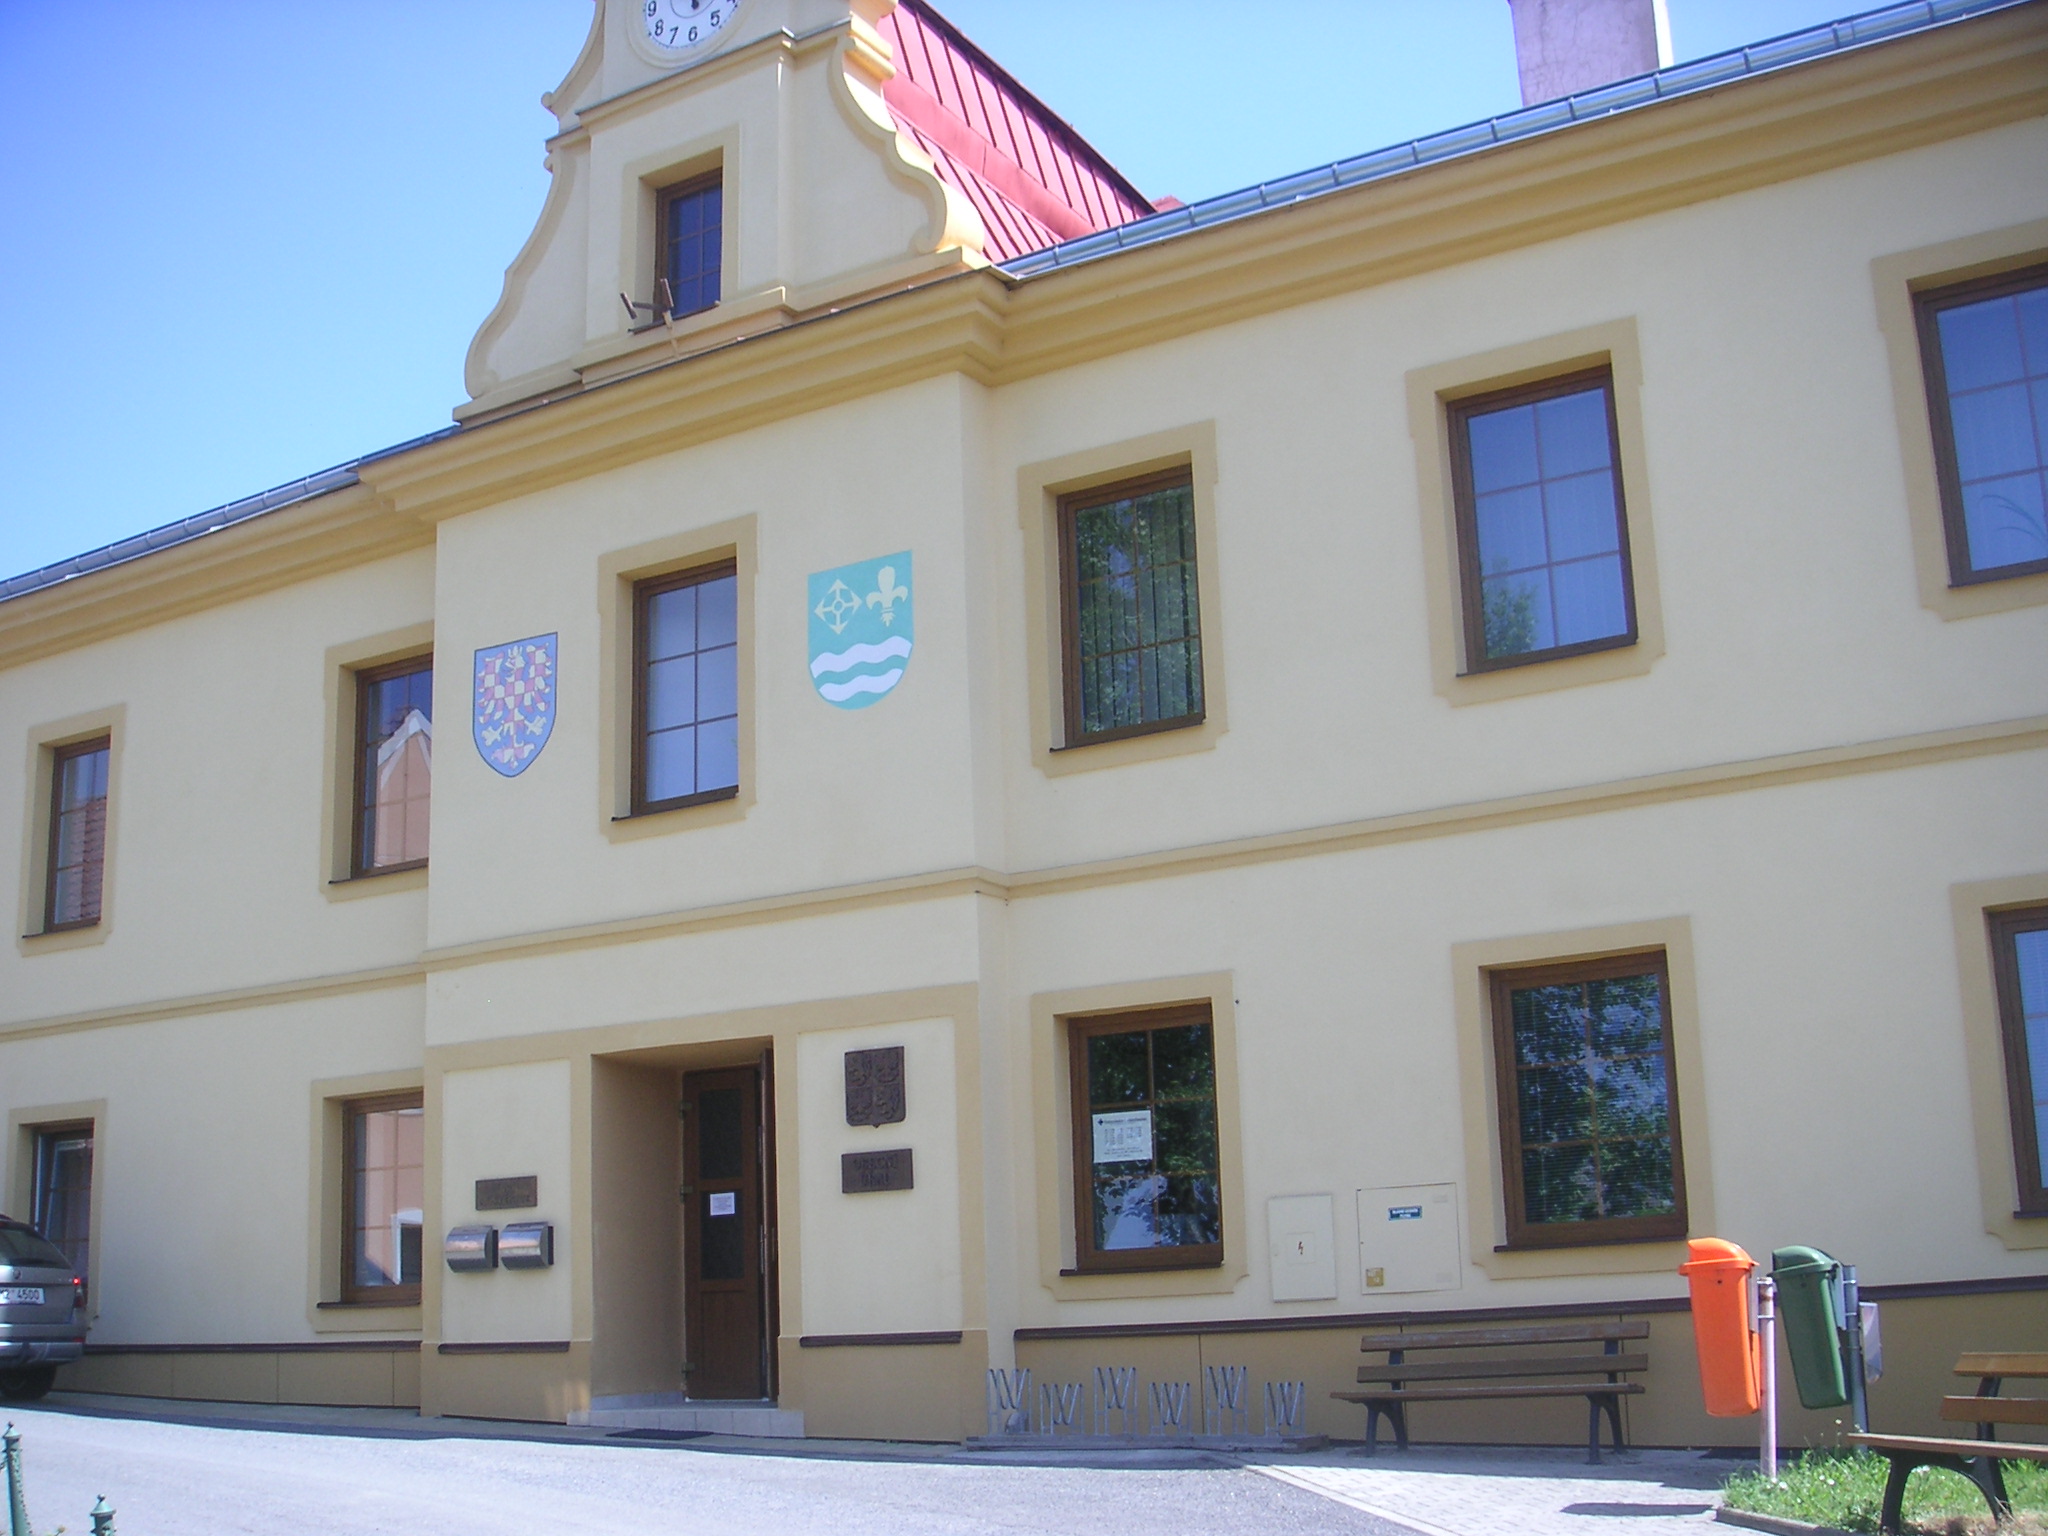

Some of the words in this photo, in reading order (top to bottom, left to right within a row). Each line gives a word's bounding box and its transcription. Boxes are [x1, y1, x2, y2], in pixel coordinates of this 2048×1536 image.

[648, 1, 656, 17] 9
[711, 10, 720, 26] 5
[655, 19, 664, 36] 8
[669, 26, 679, 44] 7
[688, 26, 698, 41] 6
